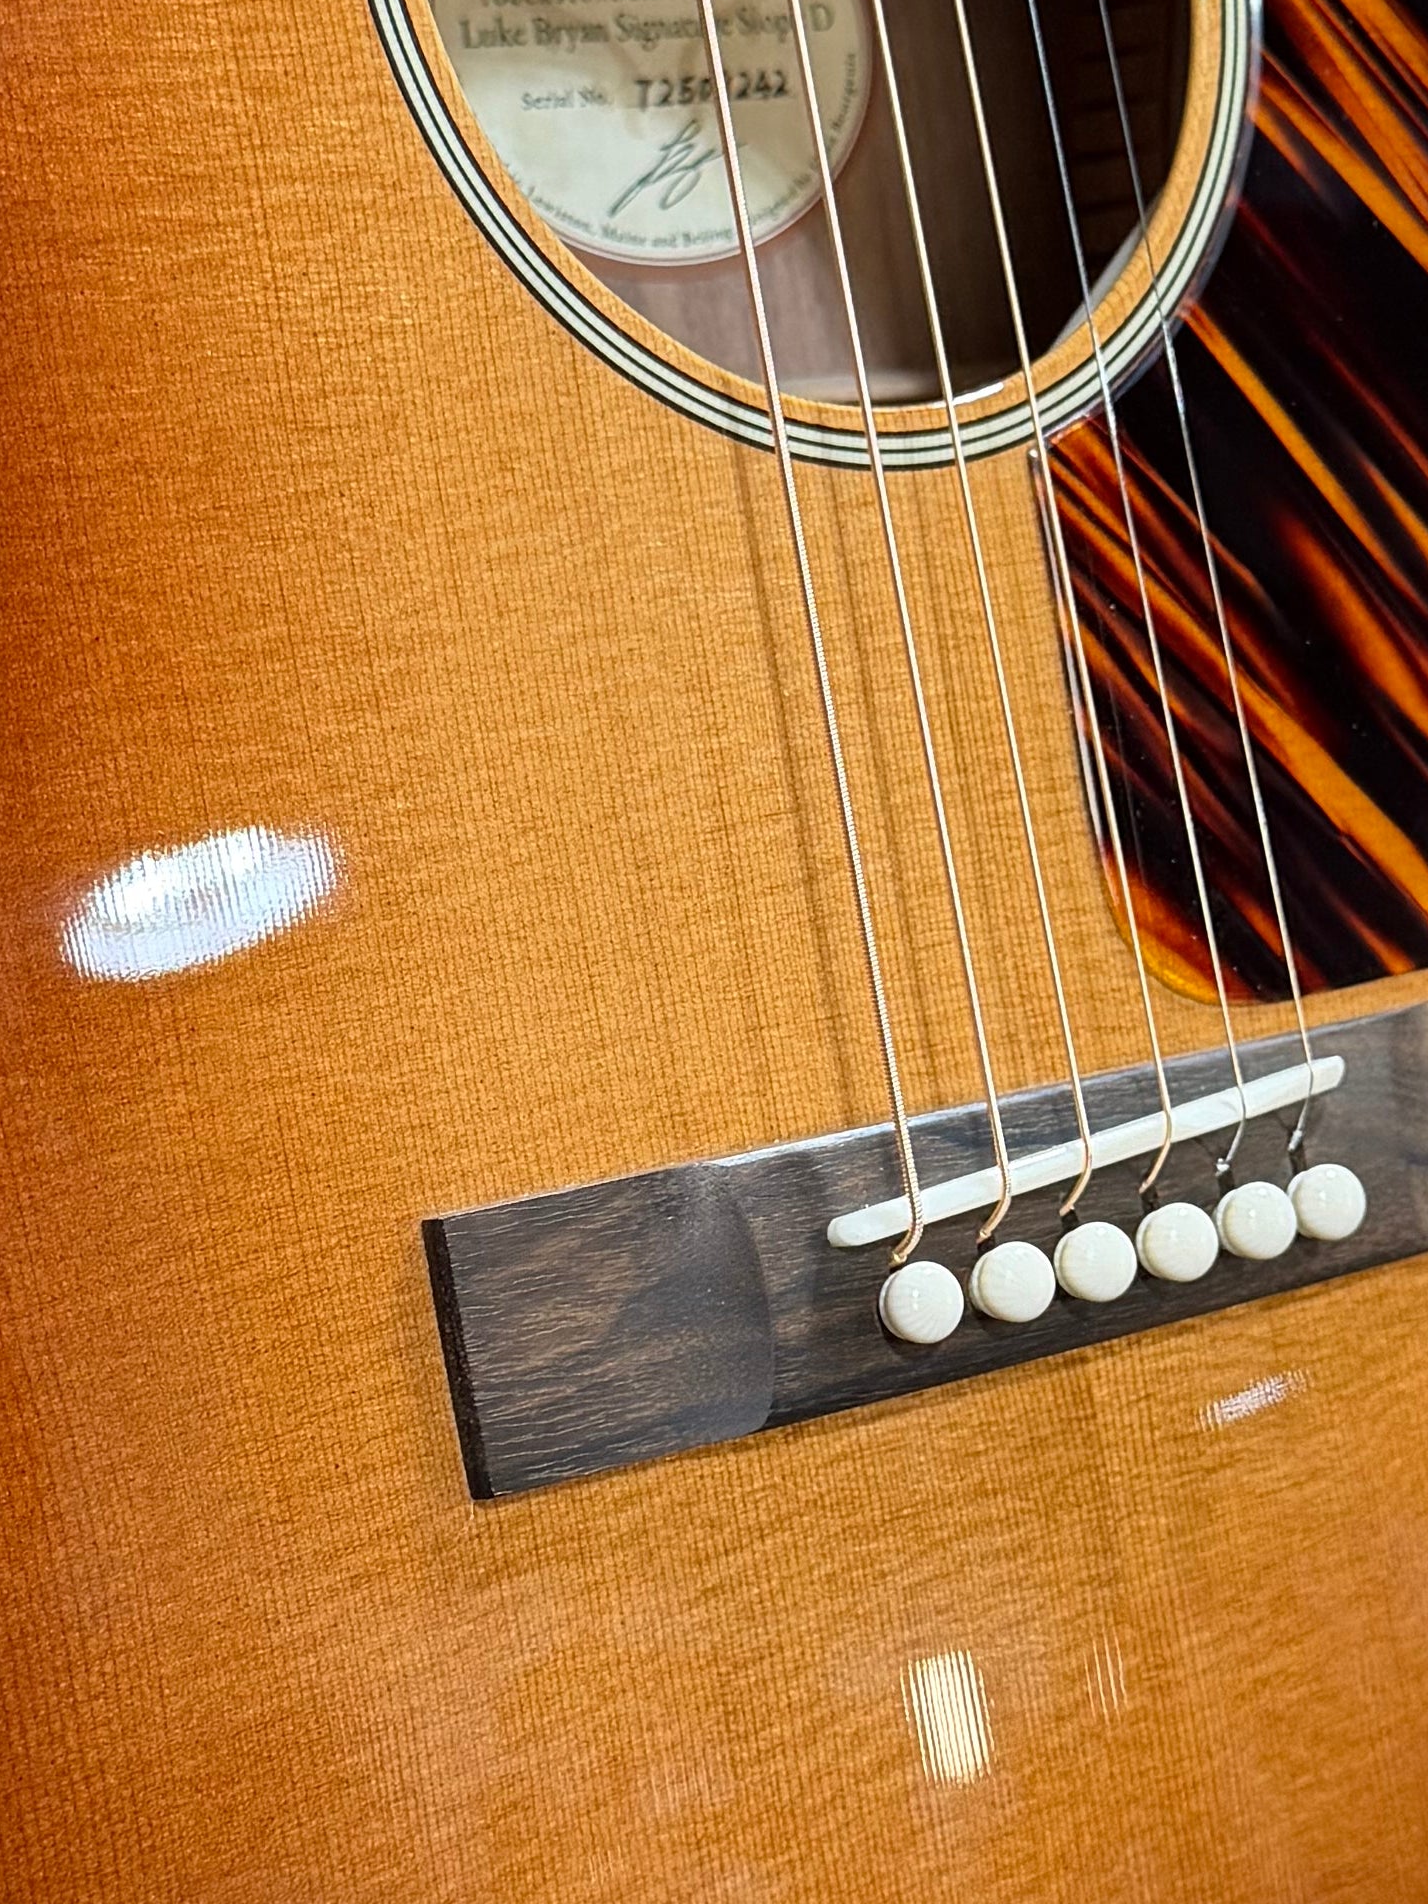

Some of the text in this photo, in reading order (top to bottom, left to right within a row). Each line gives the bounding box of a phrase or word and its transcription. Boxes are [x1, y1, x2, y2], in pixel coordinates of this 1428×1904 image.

[459, 16, 527, 49] Luke
[532, 16, 610, 53] Bryan
[734, 4, 805, 45] Slop
[810, 2, 835, 33] D
[522, 90, 573, 111] Serial
[634, 69, 789, 110] T250242
